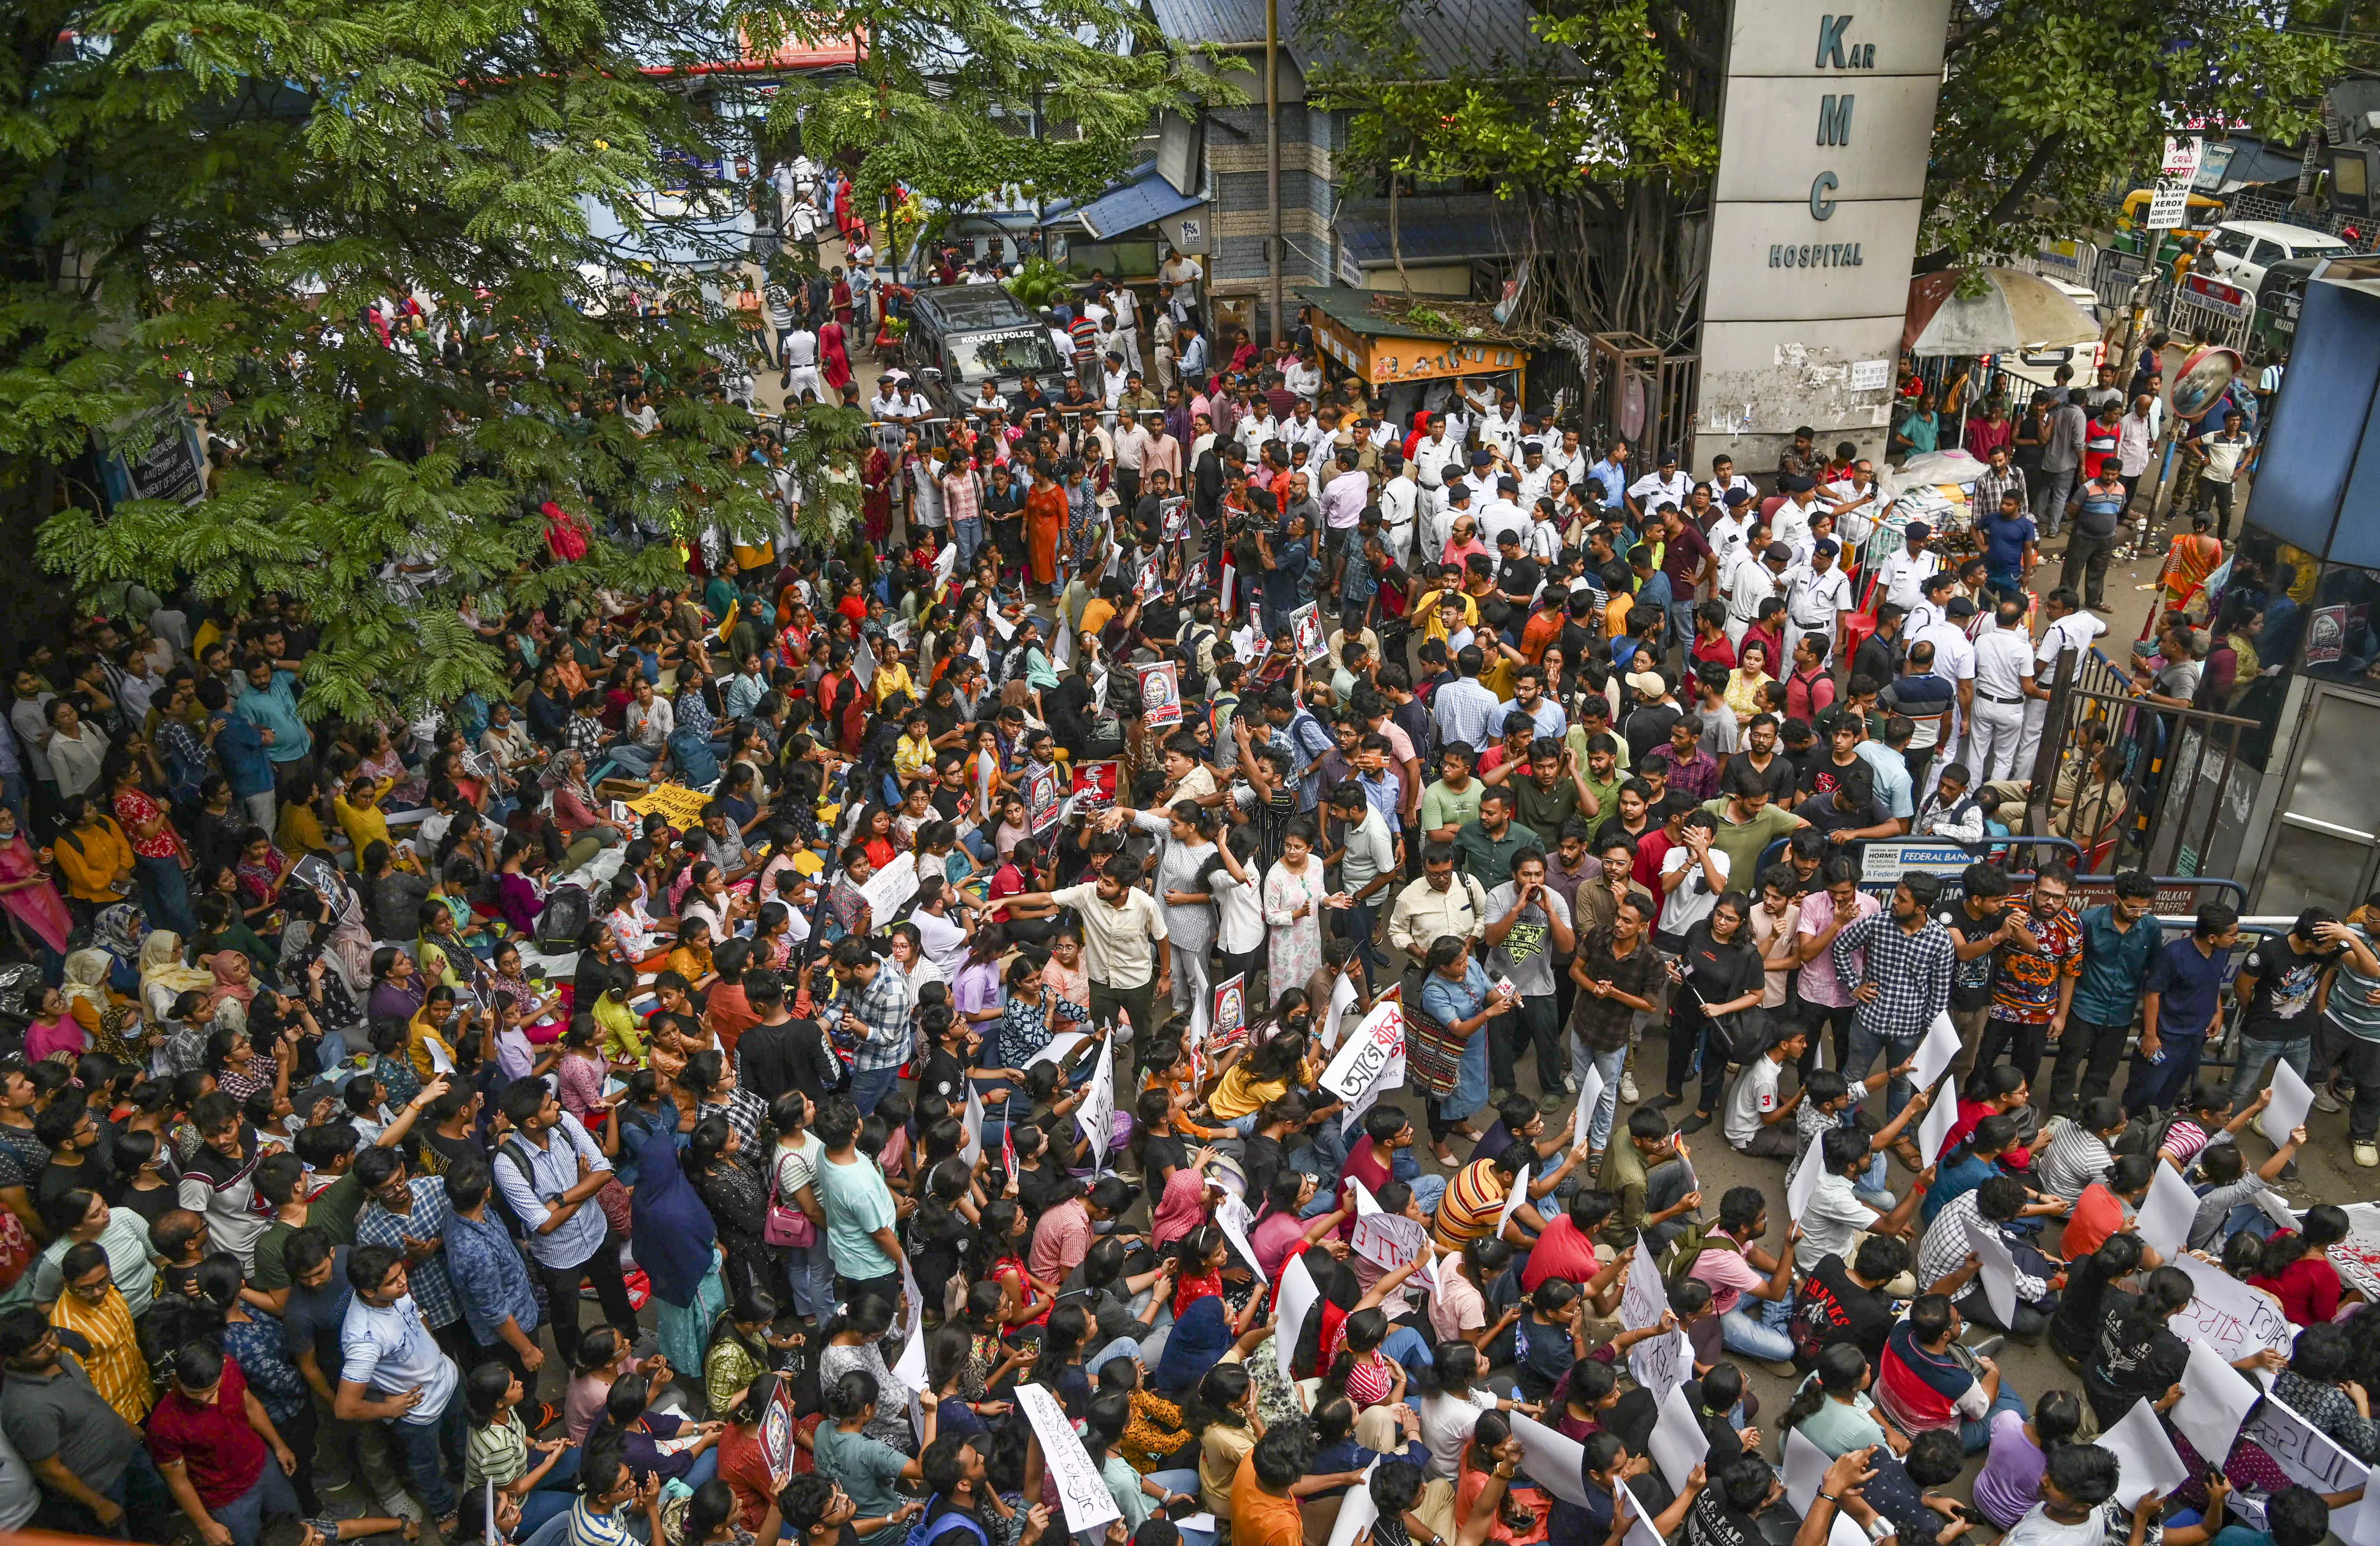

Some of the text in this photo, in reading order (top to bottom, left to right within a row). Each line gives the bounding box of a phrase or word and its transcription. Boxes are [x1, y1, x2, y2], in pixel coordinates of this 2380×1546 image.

[1816, 14, 1875, 68] KAR
[1817, 94, 1855, 146] M
[1810, 171, 1839, 221] C
[1770, 243, 1863, 268] HOSPITAL
[2204, 297, 2224, 313] TRAFFIC
[2225, 304, 2243, 318] POLICE
[2274, 318, 2294, 333] KOLKATA
[961, 330, 1035, 344] KOLKATA POLICE
[143, 468, 158, 481] AND
[679, 815, 699, 827] NO
[1904, 852, 1942, 861] FEDERAL
[2155, 891, 2192, 901] KOLKATA
[2153, 902, 2186, 912] TRAFFIC
[1515, 941, 1543, 954] COMPETITION
[1340, 1041, 1385, 1097] আগে
[1762, 1095, 1770, 1106] 3
[1805, 1276, 1850, 1326] SHANKS
[1716, 1514, 1744, 1546] KAR
